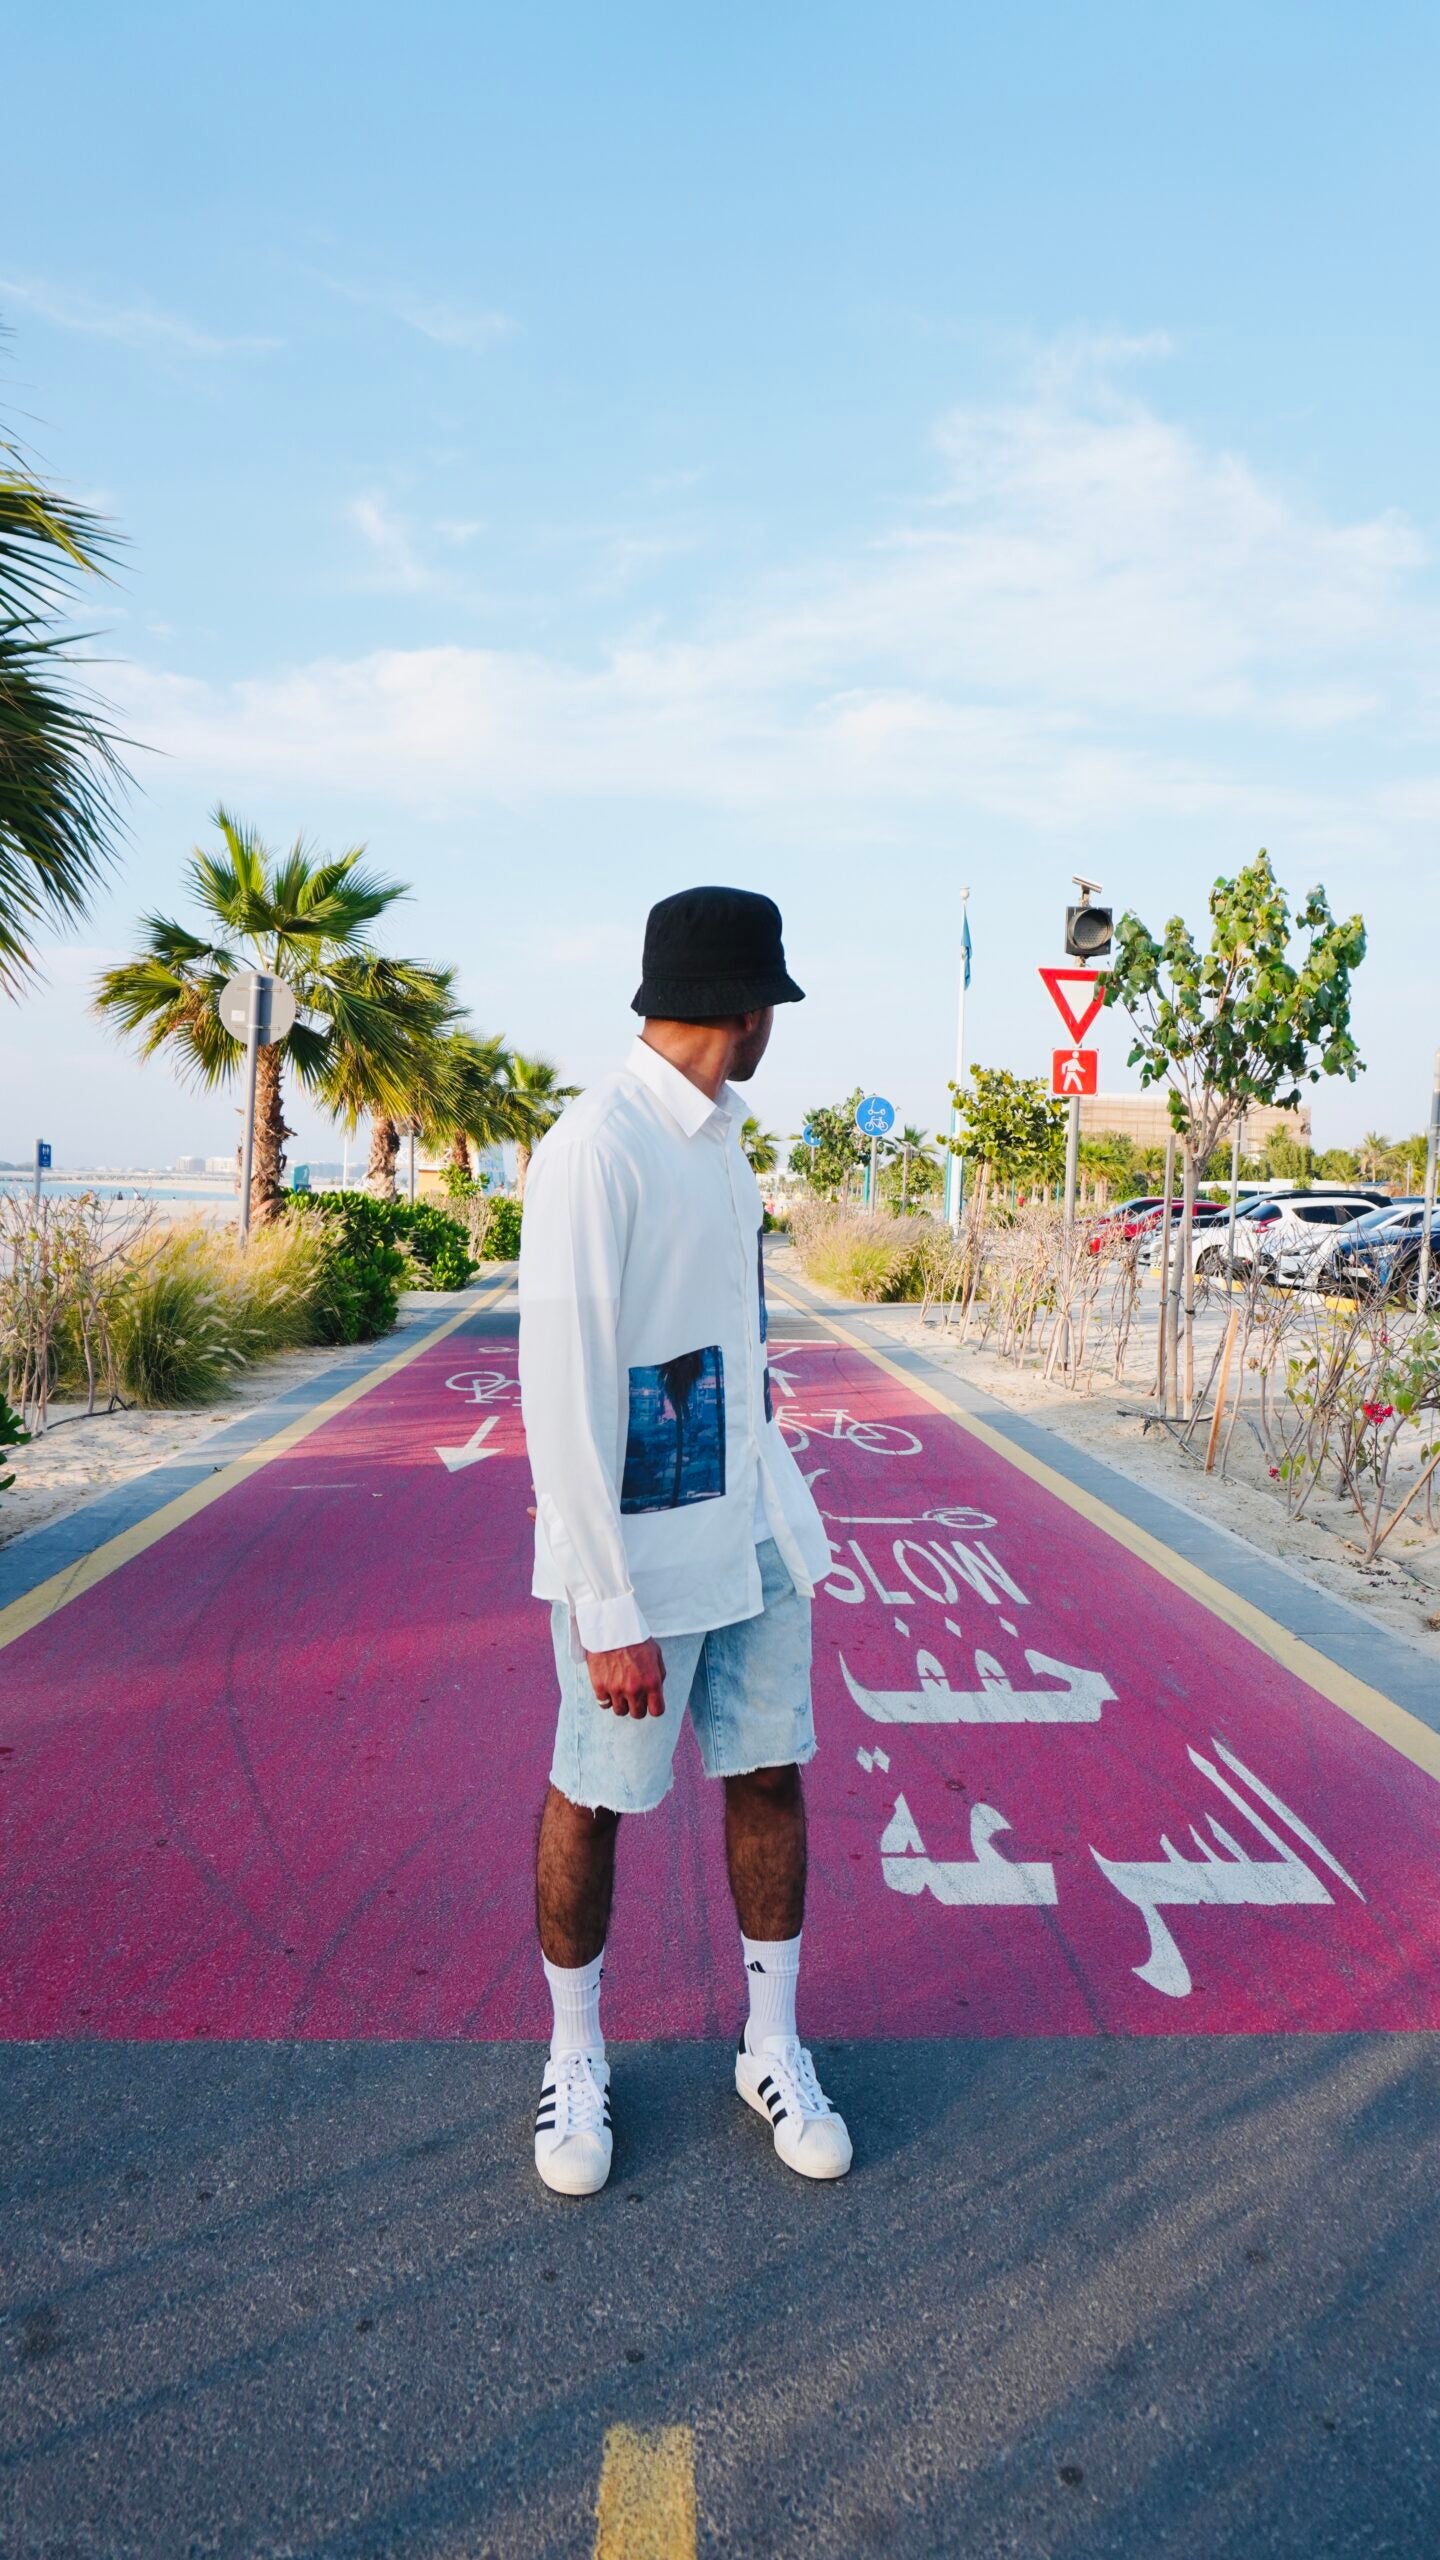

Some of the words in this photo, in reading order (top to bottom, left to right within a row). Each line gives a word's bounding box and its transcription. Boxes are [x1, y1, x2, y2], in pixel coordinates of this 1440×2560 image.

[824, 1540, 1032, 1605] SLOW
[839, 1616, 1119, 1724] خفف
[856, 1737, 1367, 1998] السرعة
